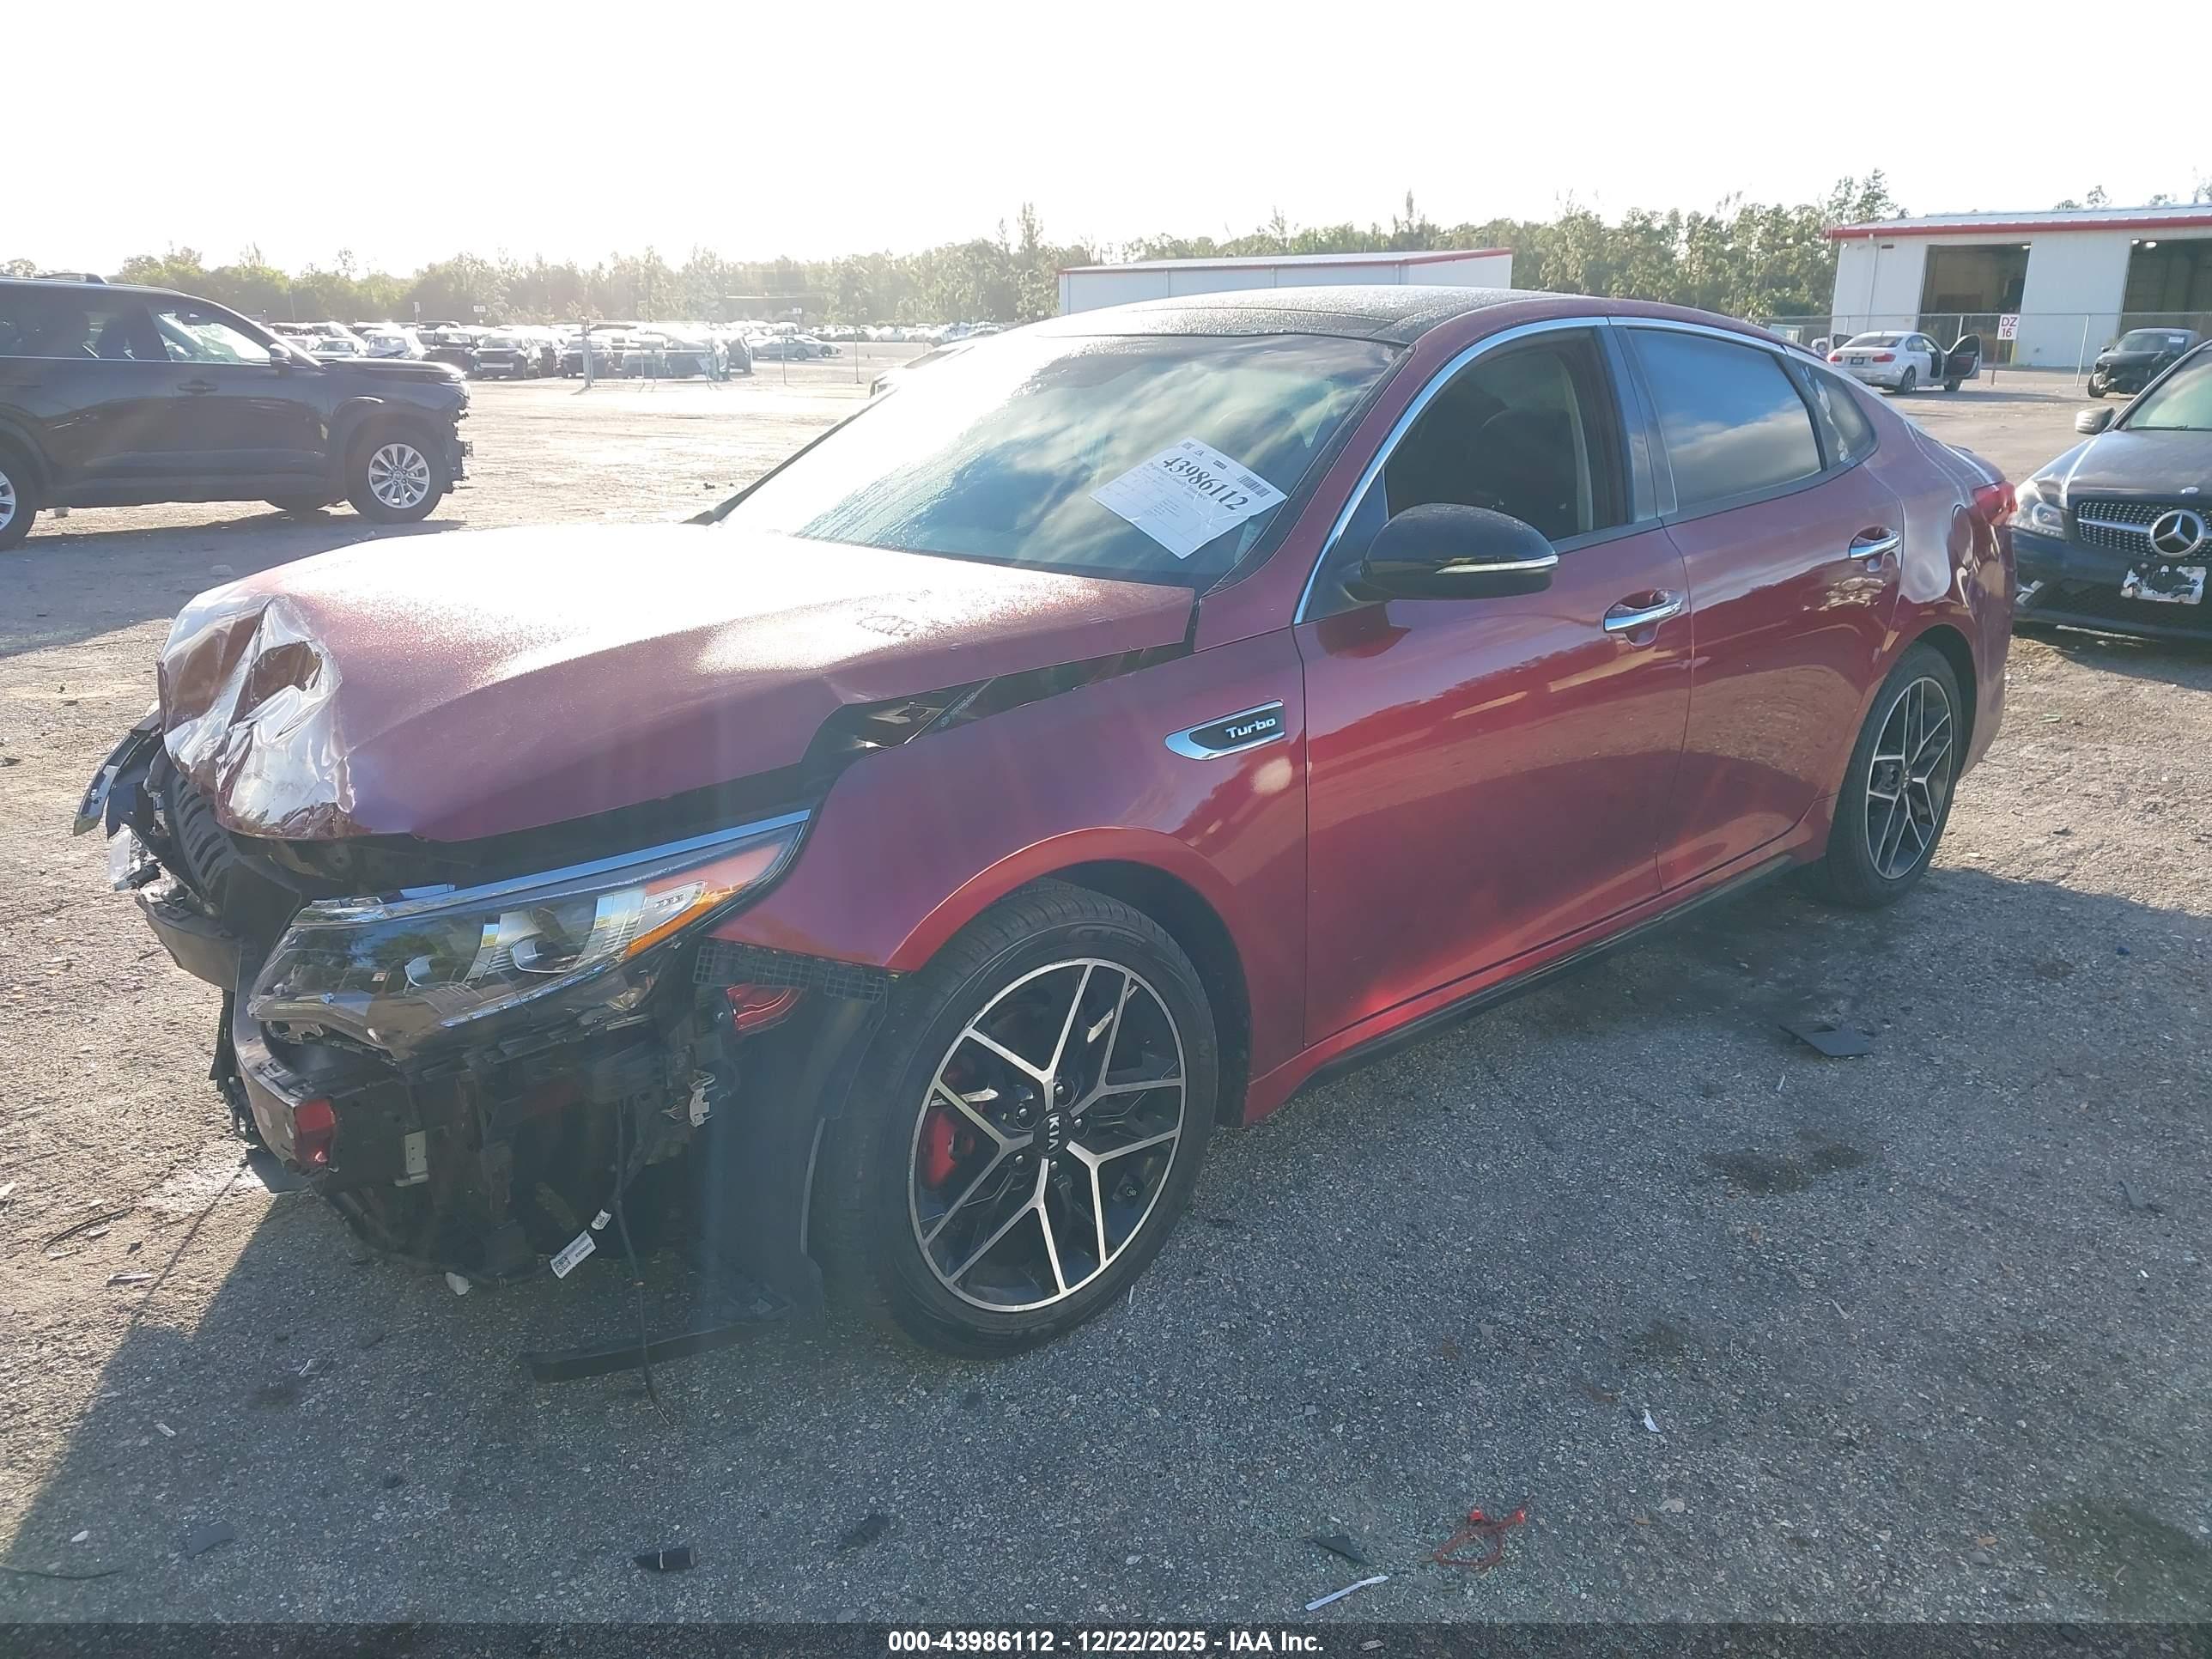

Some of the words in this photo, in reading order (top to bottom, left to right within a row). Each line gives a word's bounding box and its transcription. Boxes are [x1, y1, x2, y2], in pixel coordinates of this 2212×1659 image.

[2001, 316, 2018, 327] DZ
[2002, 327, 2012, 337] 16
[1163, 457, 1249, 511] 43986112
[1225, 717, 1276, 738] Turbo
[1048, 1115, 1060, 1151] KIA
